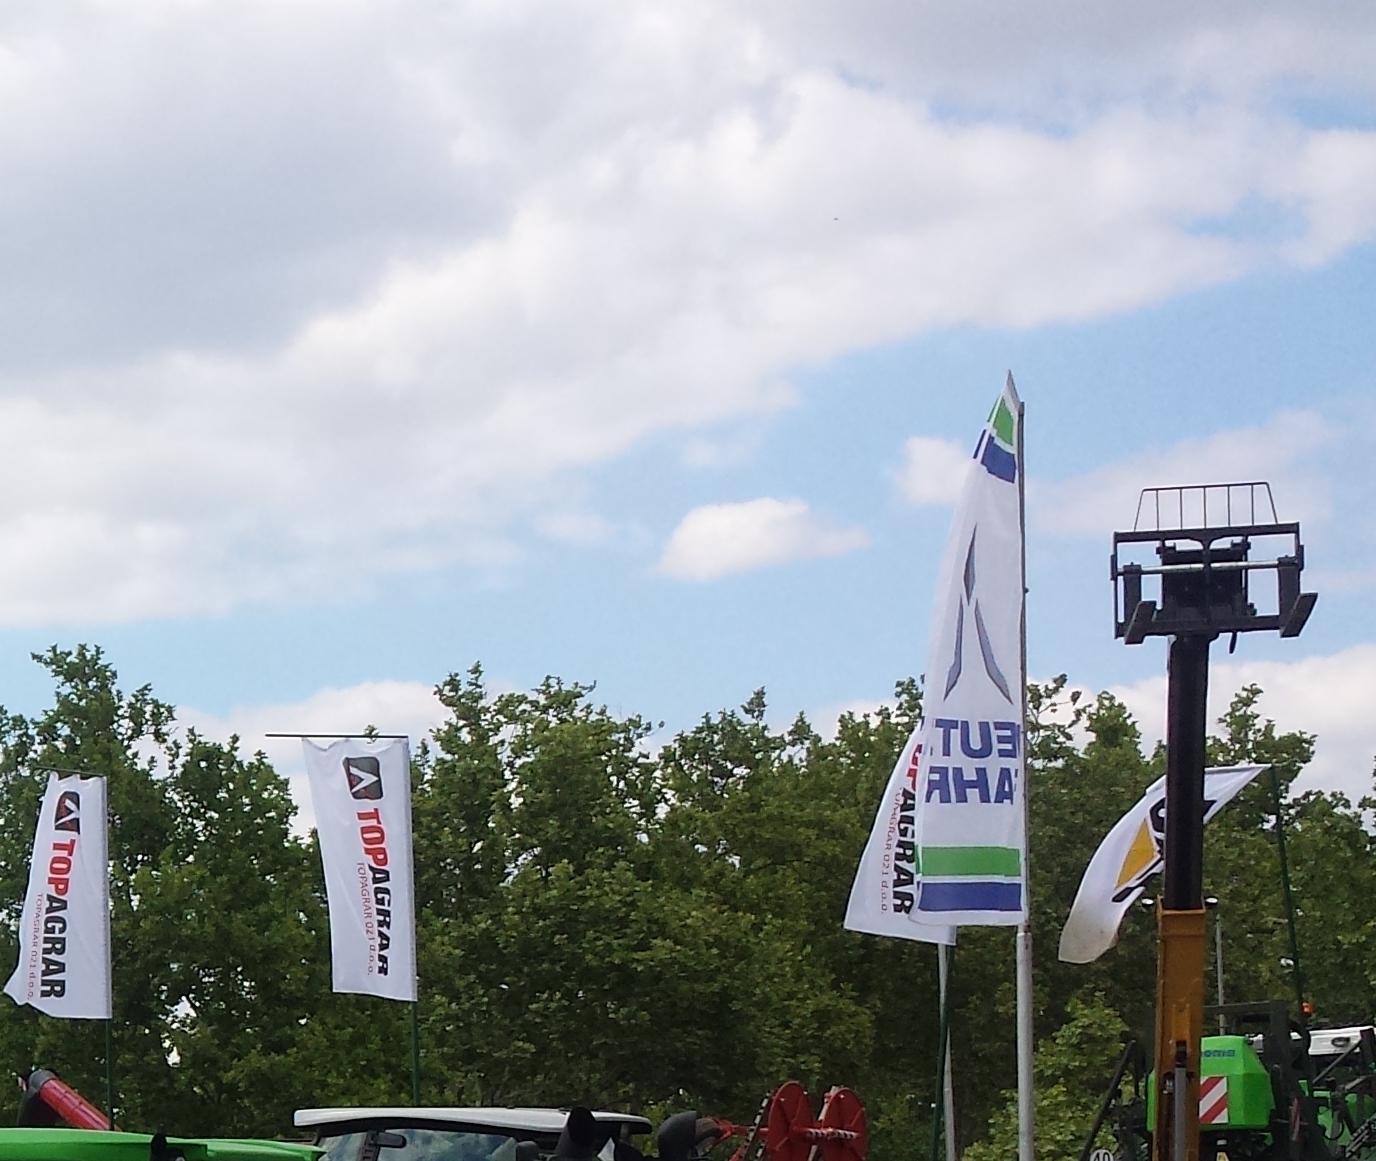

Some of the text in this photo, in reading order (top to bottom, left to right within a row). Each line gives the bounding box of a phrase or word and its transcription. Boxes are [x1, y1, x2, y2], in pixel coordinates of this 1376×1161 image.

[31, 892, 44, 948] TOPAGRAR
[39, 838, 77, 999] TOPAGRAR
[354, 807, 392, 977] TOPAGRAR
[356, 861, 373, 919] TOPAGRAR
